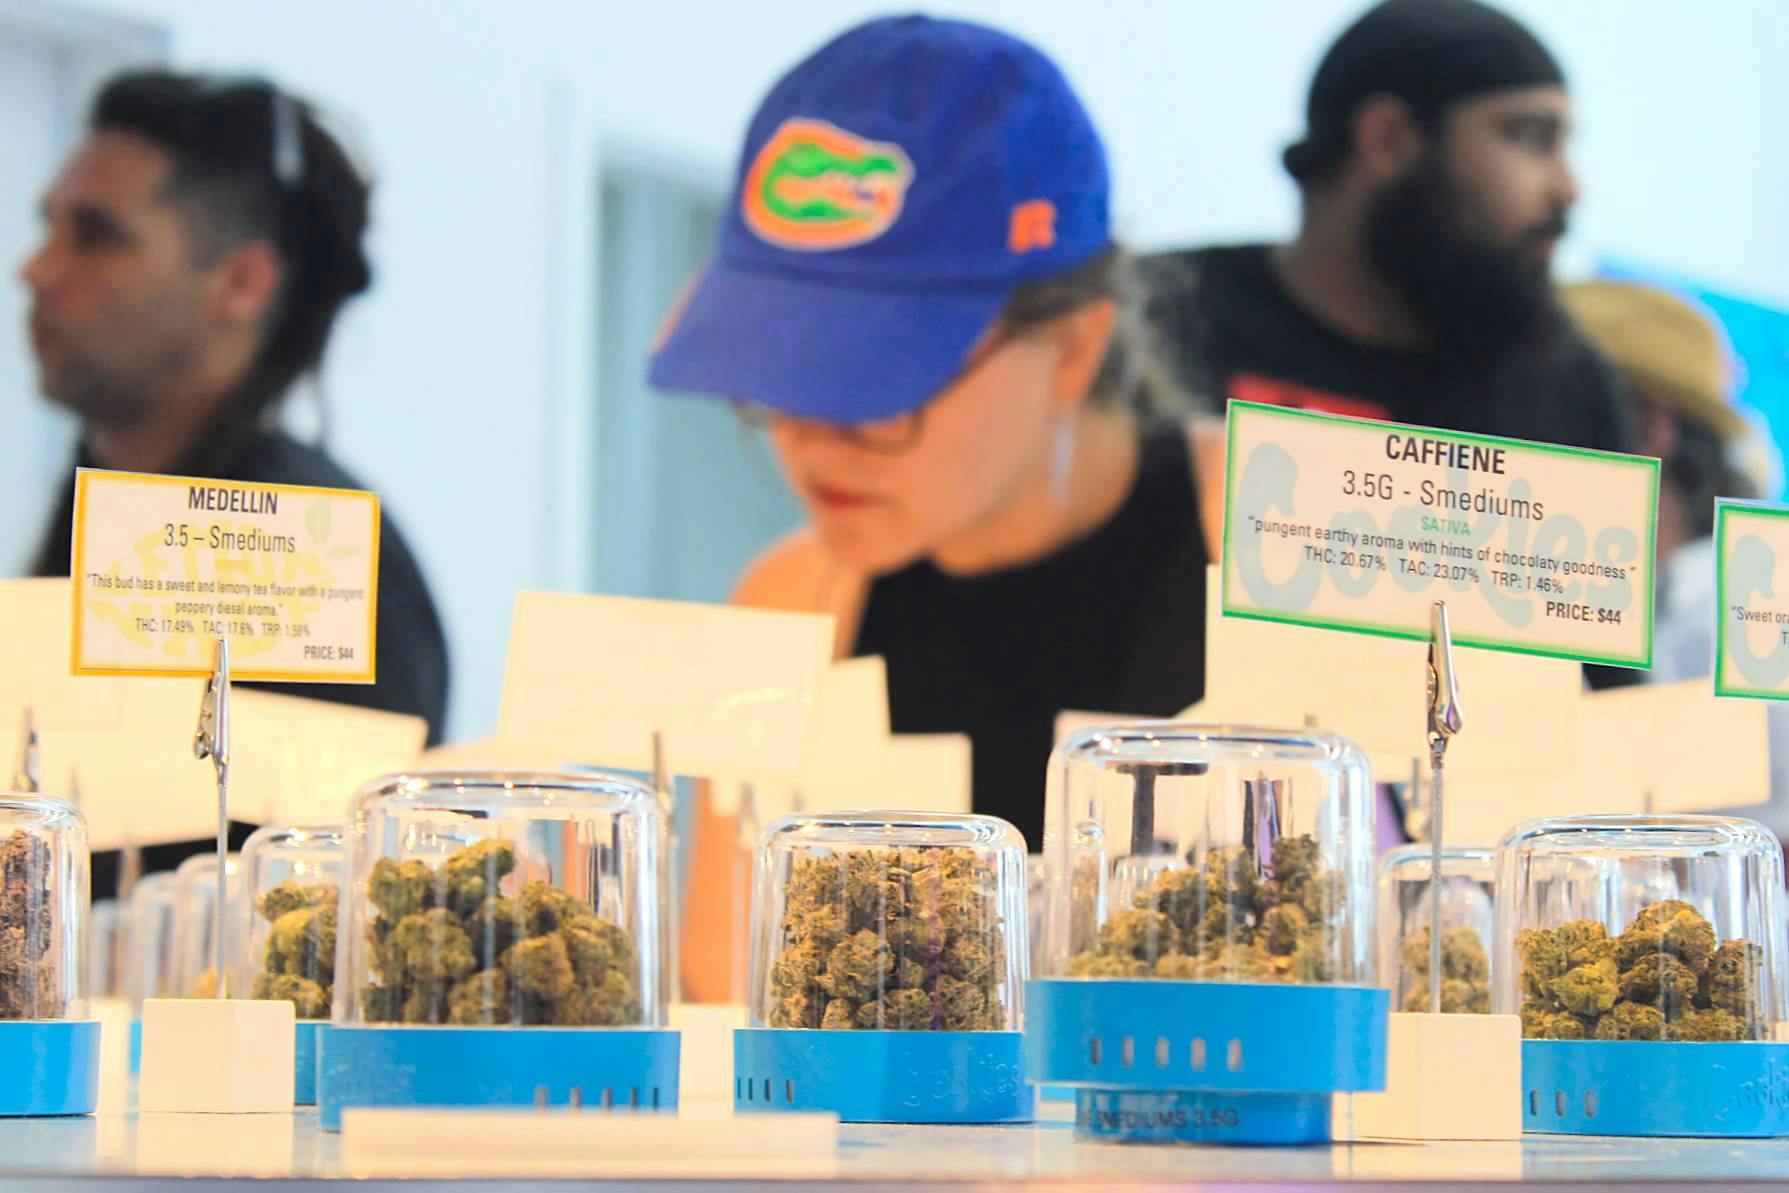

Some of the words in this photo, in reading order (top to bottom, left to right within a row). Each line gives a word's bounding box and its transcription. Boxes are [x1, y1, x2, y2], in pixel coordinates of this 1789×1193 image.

[1385, 434, 1506, 475] CAFFIENE
[188, 486, 278, 514] MEDELLIN
[1343, 470, 1394, 500] 3.5G
[1420, 480, 1544, 521] Smediums
[164, 523, 188, 547] 3.5
[210, 525, 295, 553] Smediums
[1421, 515, 1471, 537] SATIVA
[1248, 515, 1311, 538] "pungent
[1315, 528, 1358, 546] earthy
[1362, 533, 1404, 550] aroma
[1408, 538, 1437, 555] with
[1441, 541, 1473, 559] hints
[1477, 547, 1491, 561] of
[1494, 550, 1560, 571] chocolaty
[1304, 545, 1336, 564] THC:
[1340, 551, 1387, 571] 20.67%
[1398, 558, 1430, 576] TAC:
[1433, 563, 1480, 583] 23.07%
[1491, 571, 1521, 588] TRP:
[1526, 576, 1564, 594] 1.46%
[115, 576, 133, 589] bud
[136, 576, 154, 590] has
[157, 581, 163, 590] a
[166, 580, 195, 592] sweet
[198, 580, 214, 593] and
[217, 581, 250, 596] lemony
[253, 583, 267, 595] tea
[270, 582, 296, 596] flavor
[298, 584, 318, 597] with
[320, 588, 326, 598] a
[328, 587, 364, 601] pungent
[175, 602, 214, 616] peppery
[217, 601, 245, 615] diesel
[1547, 601, 1593, 621] PRICE:
[1598, 608, 1622, 625] $44
[1731, 606, 1772, 622] "Sweet
[136, 618, 158, 632] THC:
[161, 619, 194, 633] 17.49%
[203, 620, 224, 635] TAC:
[227, 622, 253, 636] 17.6%
[262, 622, 282, 636] TRP:
[304, 645, 336, 660] PRICE:
[338, 647, 354, 660] $44
